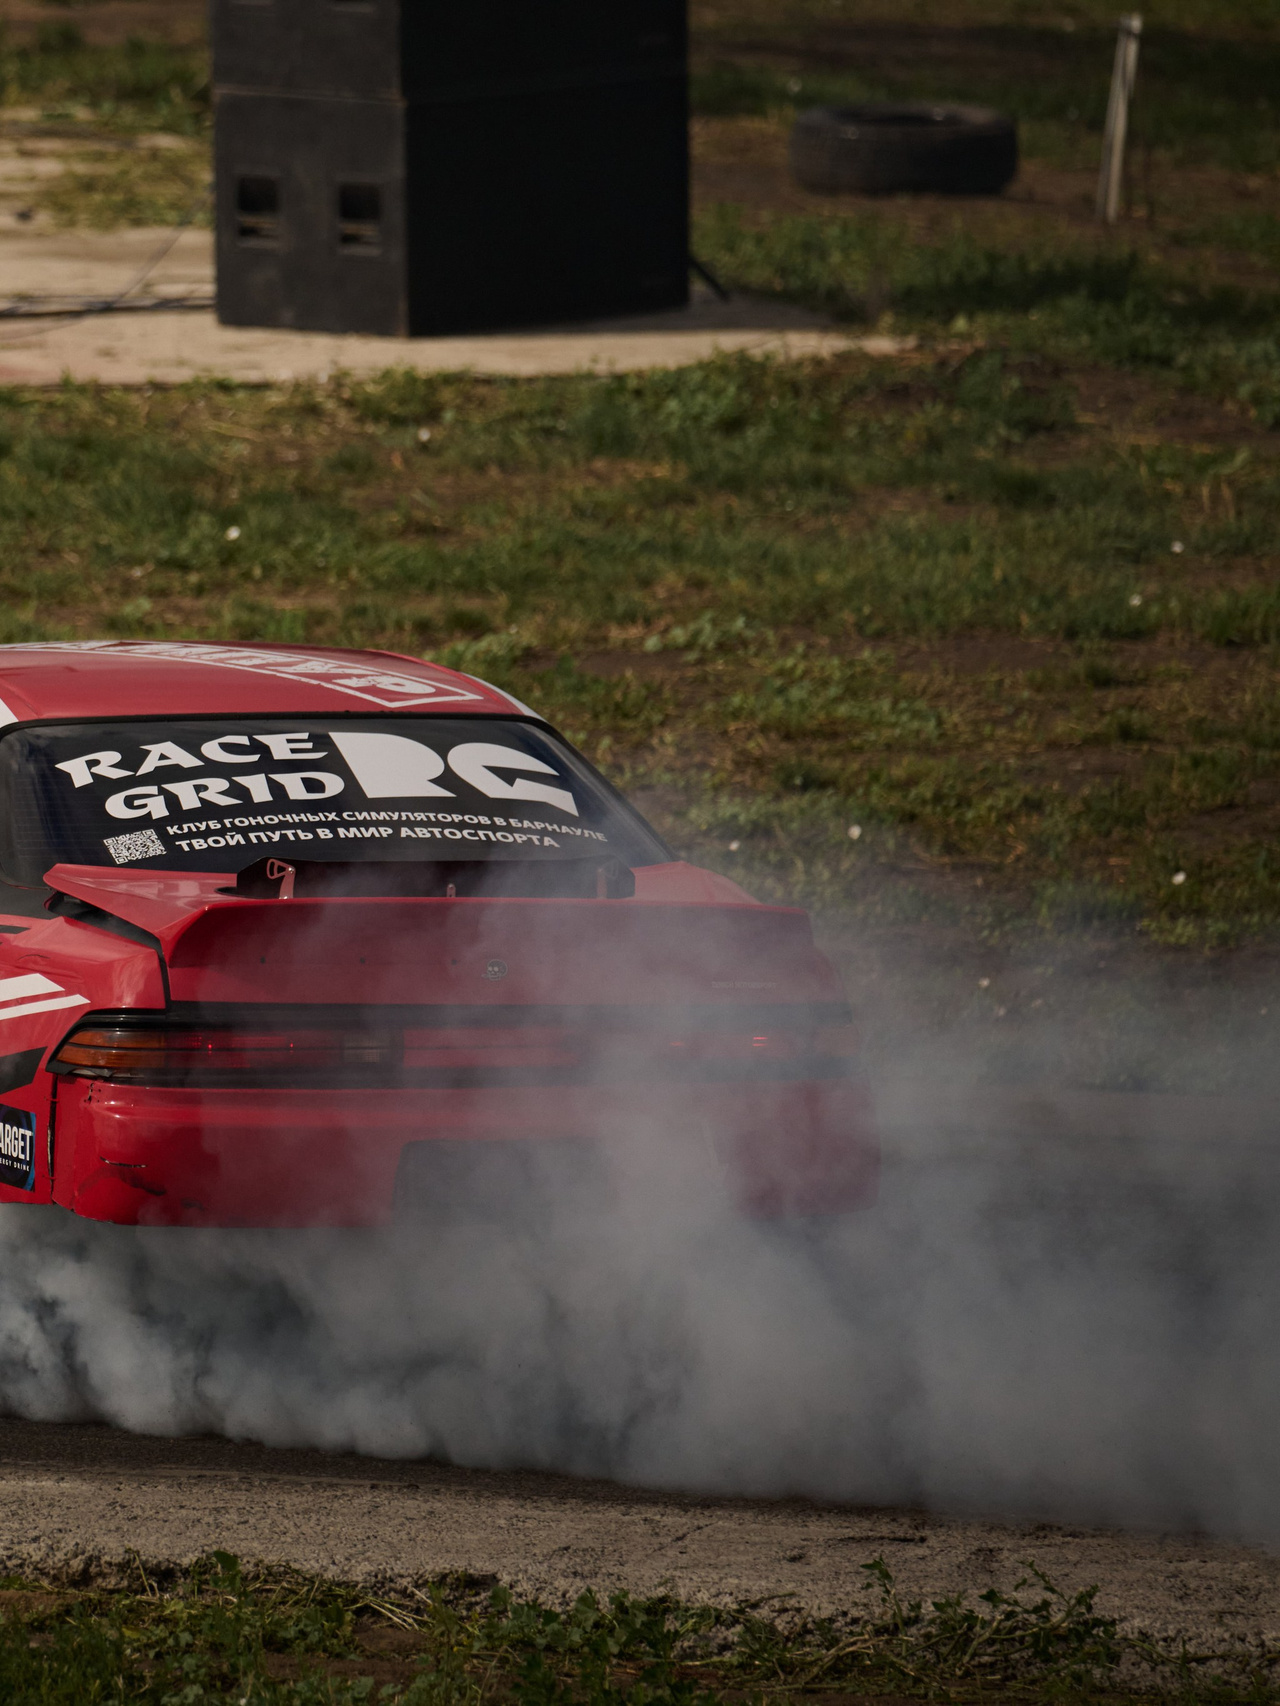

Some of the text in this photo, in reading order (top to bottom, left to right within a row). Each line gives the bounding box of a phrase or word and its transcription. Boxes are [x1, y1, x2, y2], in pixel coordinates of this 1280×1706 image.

[54, 732, 328, 788] RACE
[105, 771, 345, 820] GRID
[166, 811, 608, 842] КЛУБ ГОНОЧНЫХ СИМУЛЯТОРОВ В БАРНАУЛЕ
[175, 826, 560, 852] ТВОЙ ПУТЬ В МИР АВТОСПОРТА
[13, 1162, 30, 1172] DRINK
